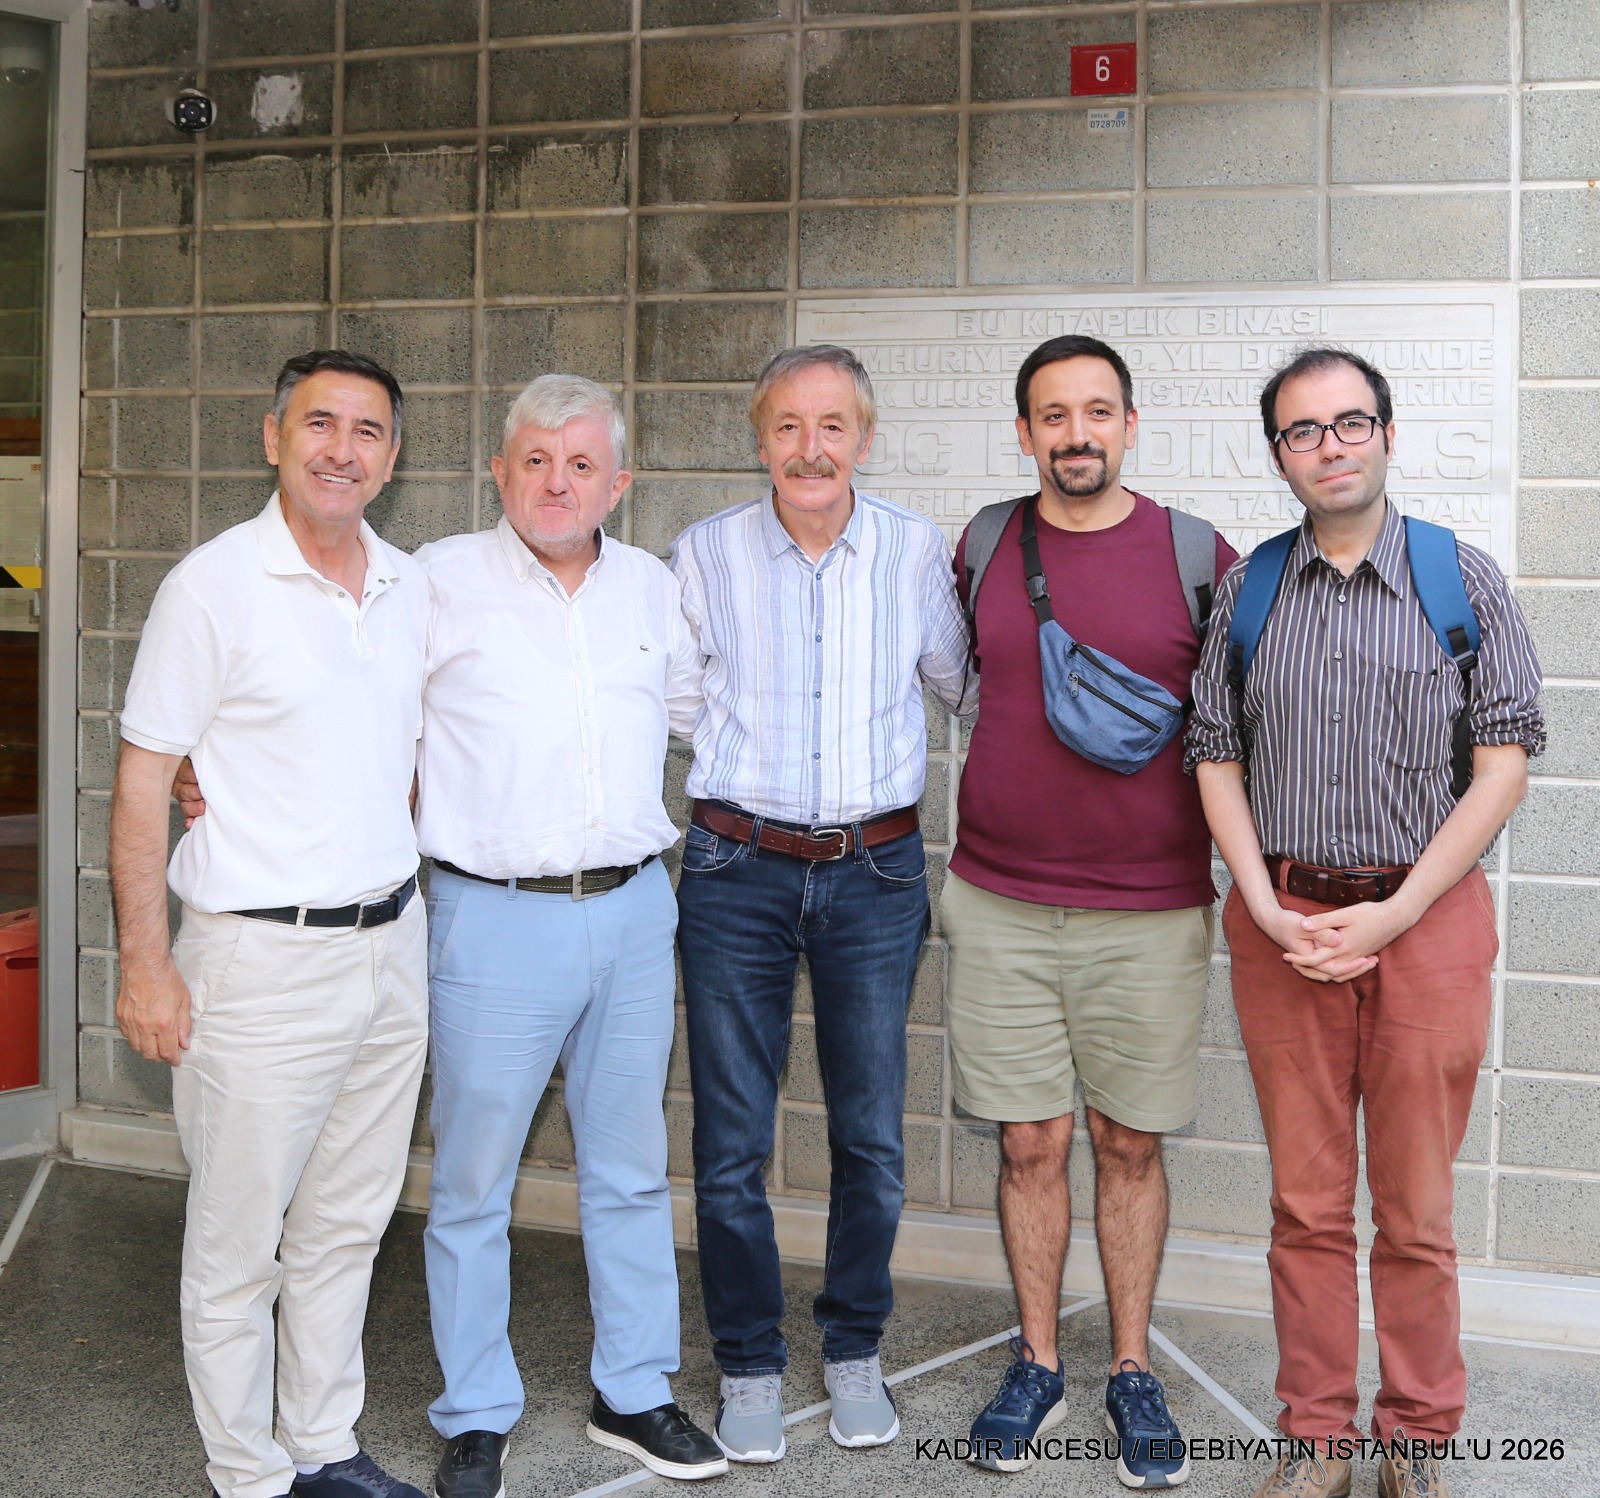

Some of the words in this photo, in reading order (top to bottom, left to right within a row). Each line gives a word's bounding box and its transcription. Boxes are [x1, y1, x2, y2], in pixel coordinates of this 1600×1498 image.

[1095, 55, 1110, 82] 6
[1090, 120, 1126, 129] 0728709
[956, 310, 1006, 337] BU
